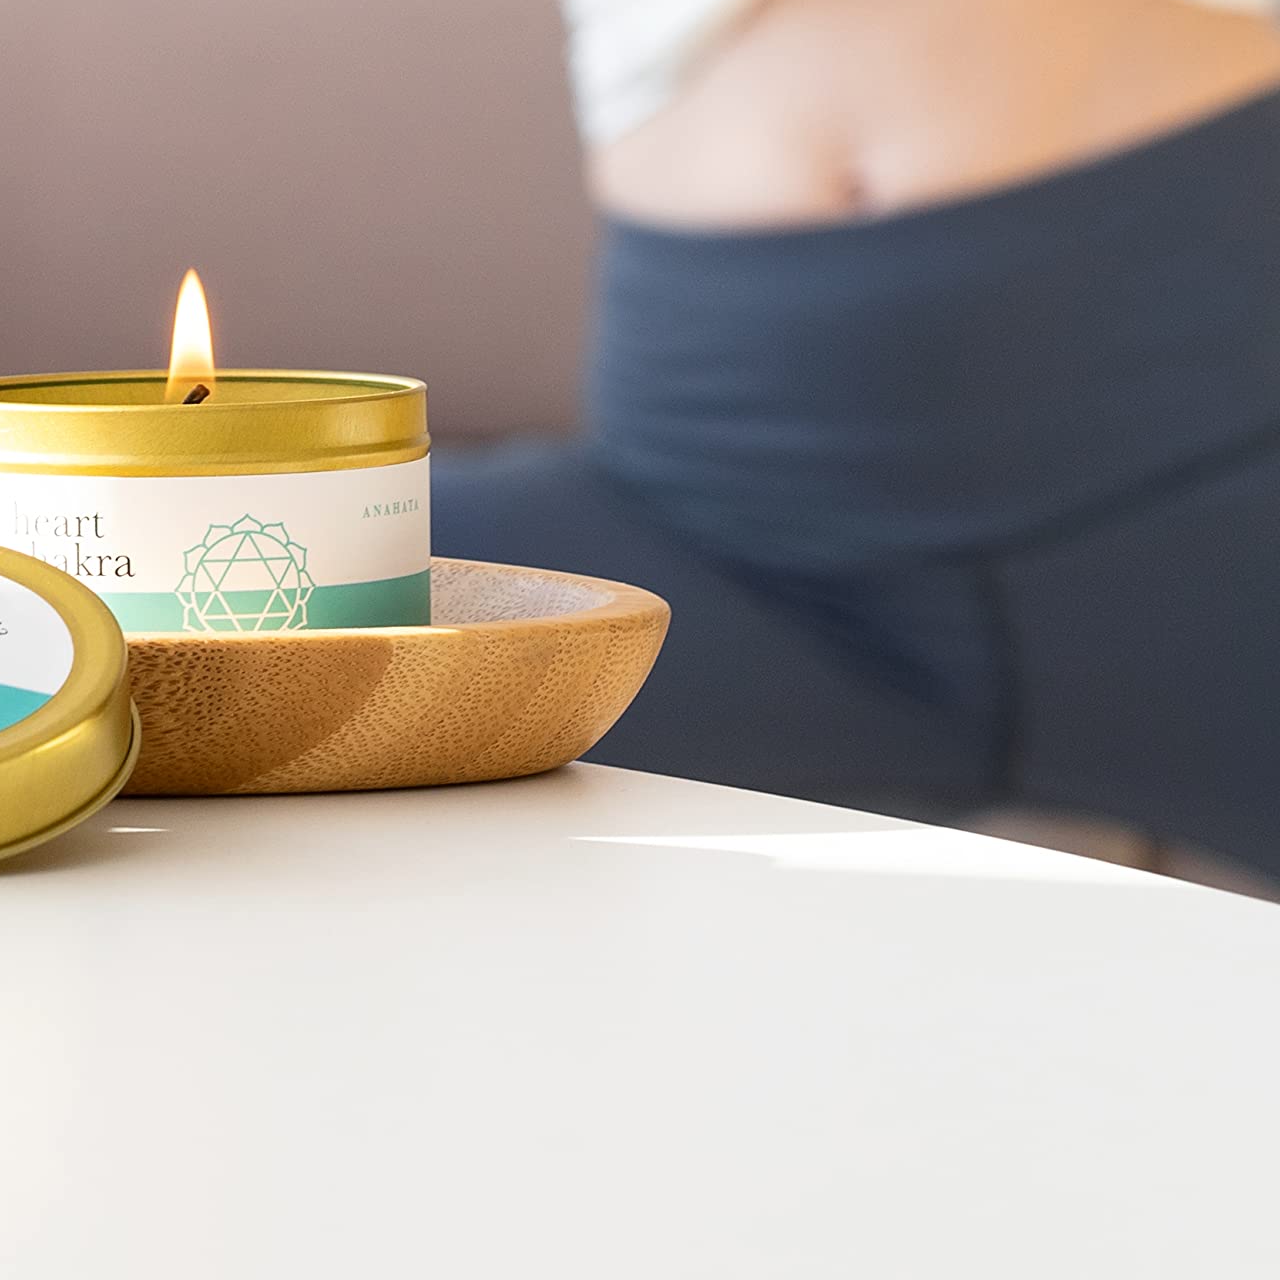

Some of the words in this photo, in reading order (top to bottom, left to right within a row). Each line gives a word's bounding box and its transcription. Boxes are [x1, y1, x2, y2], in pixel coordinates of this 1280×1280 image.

[13, 500, 105, 539] heart
[362, 497, 420, 519] ANAHATA
[31, 540, 137, 578] akra
